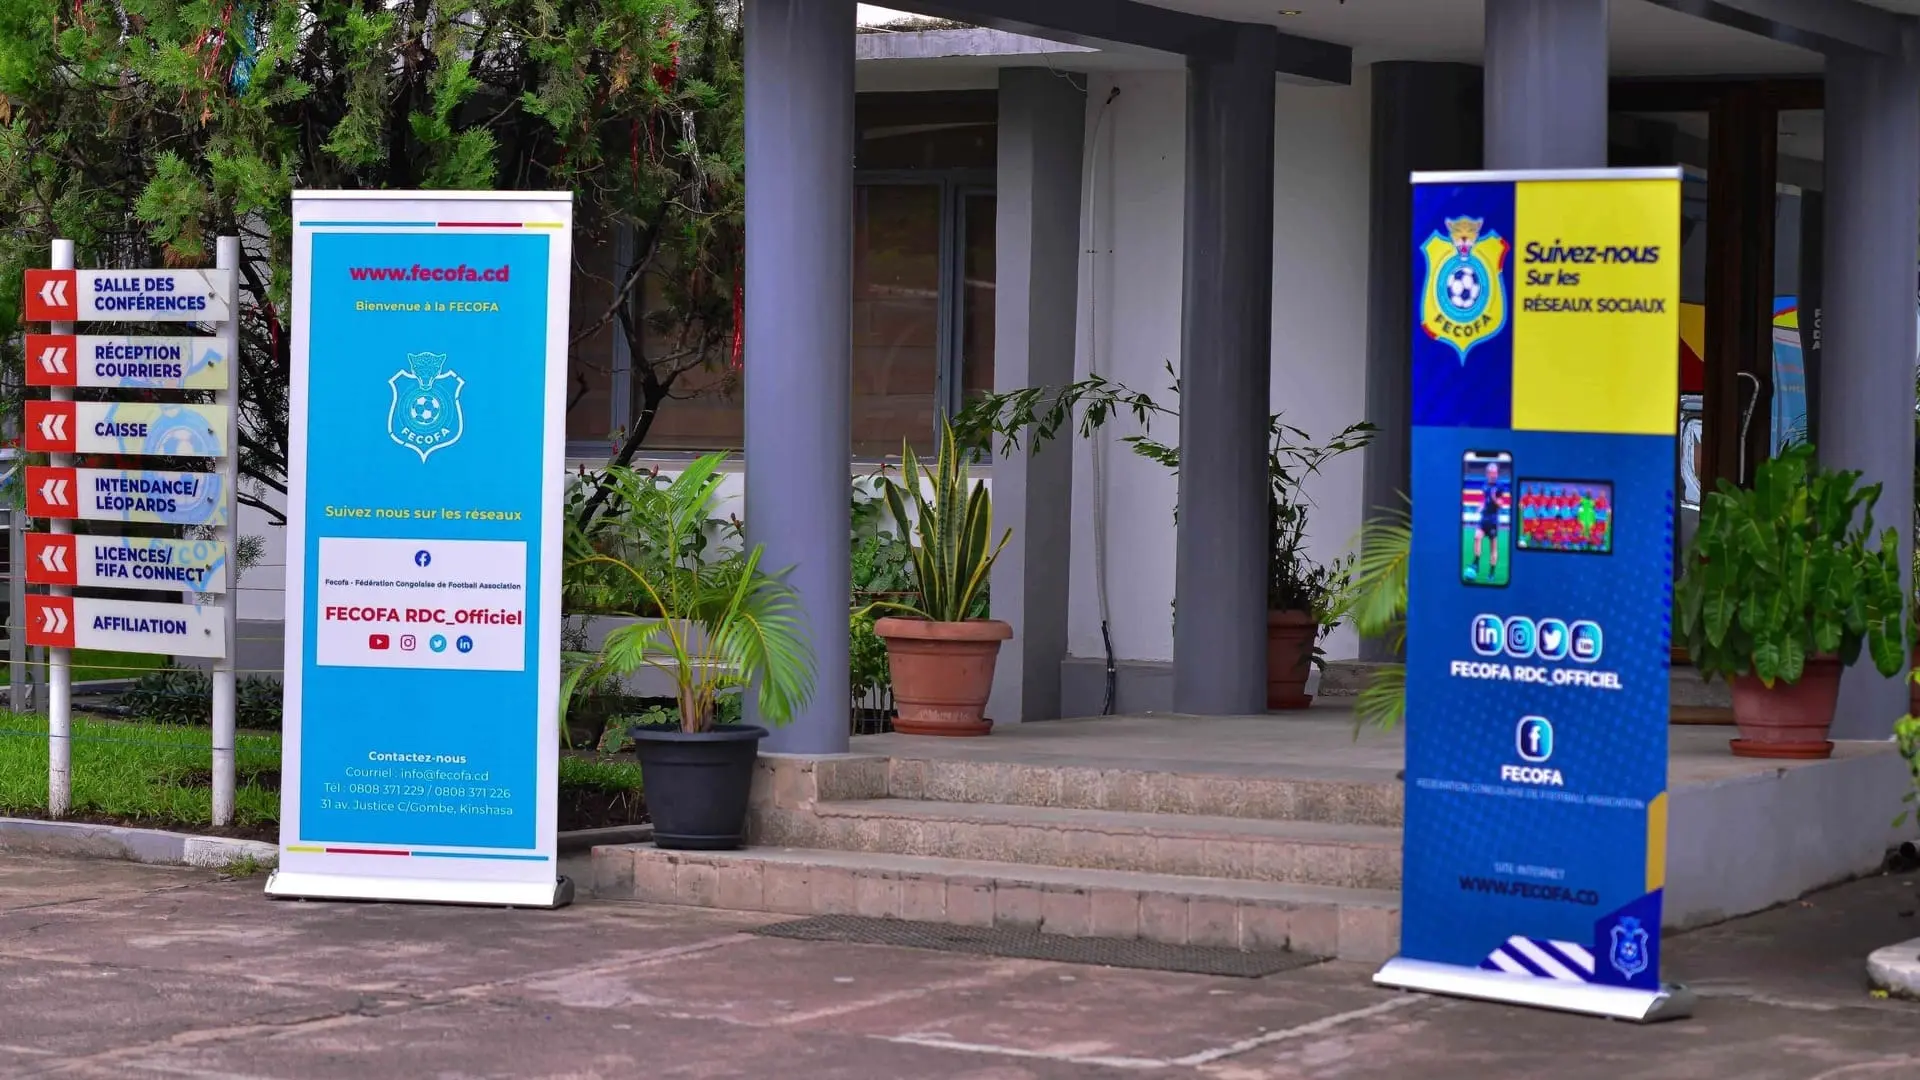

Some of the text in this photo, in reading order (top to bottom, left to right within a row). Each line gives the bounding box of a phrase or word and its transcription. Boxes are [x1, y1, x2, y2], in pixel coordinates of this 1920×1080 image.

[1524, 238, 1660, 264] Suivez-nous
[350, 264, 509, 282] www.fecofa.cd
[1526, 269, 1580, 286] Sur les
[94, 277, 174, 292] SALLE DES
[94, 293, 206, 311] CONFÉRENCES
[356, 300, 499, 313] Bienvenue à la FECOFA
[1523, 293, 1666, 313] RÉSEAUX SOCIAUX
[1434, 314, 1491, 337] FECOFA
[95, 341, 181, 360] RÉCEPTION
[95, 363, 182, 378] COURRIERS
[95, 423, 147, 437] CAISSE
[401, 427, 450, 444] FECOFA
[95, 478, 199, 497] INTENDANCE/
[96, 493, 177, 513] LÉOPARDS
[325, 505, 522, 521] Suivez nous sur les réseaux
[95, 546, 173, 565] LICENCES/
[95, 563, 204, 583] FIFA CONNECT
[325, 578, 349, 586] Fecofa
[355, 578, 394, 588] Fédération
[395, 580, 435, 589] Congolaise
[448, 581, 478, 589] Football
[479, 582, 521, 590] Association
[325, 606, 522, 626] FECOFA RDC_Officiel
[93, 616, 187, 635] AFFILIATION
[1451, 660, 1623, 690] FECOFA RDC_OFFICIEL
[368, 751, 467, 763] Contactez-nous
[345, 766, 392, 778] Courriel
[401, 768, 489, 781] info@fecofa.cd
[1501, 765, 1563, 786] FECOFA
[324, 782, 340, 793] Tél
[349, 783, 379, 794] 0808
[382, 785, 400, 795] 371
[403, 785, 424, 796] 229
[434, 786, 465, 797] 0808
[468, 787, 487, 798] 371
[490, 788, 511, 799] 226
[321, 799, 513, 815] 31 av. Justice C/Gombe, Kinshasa
